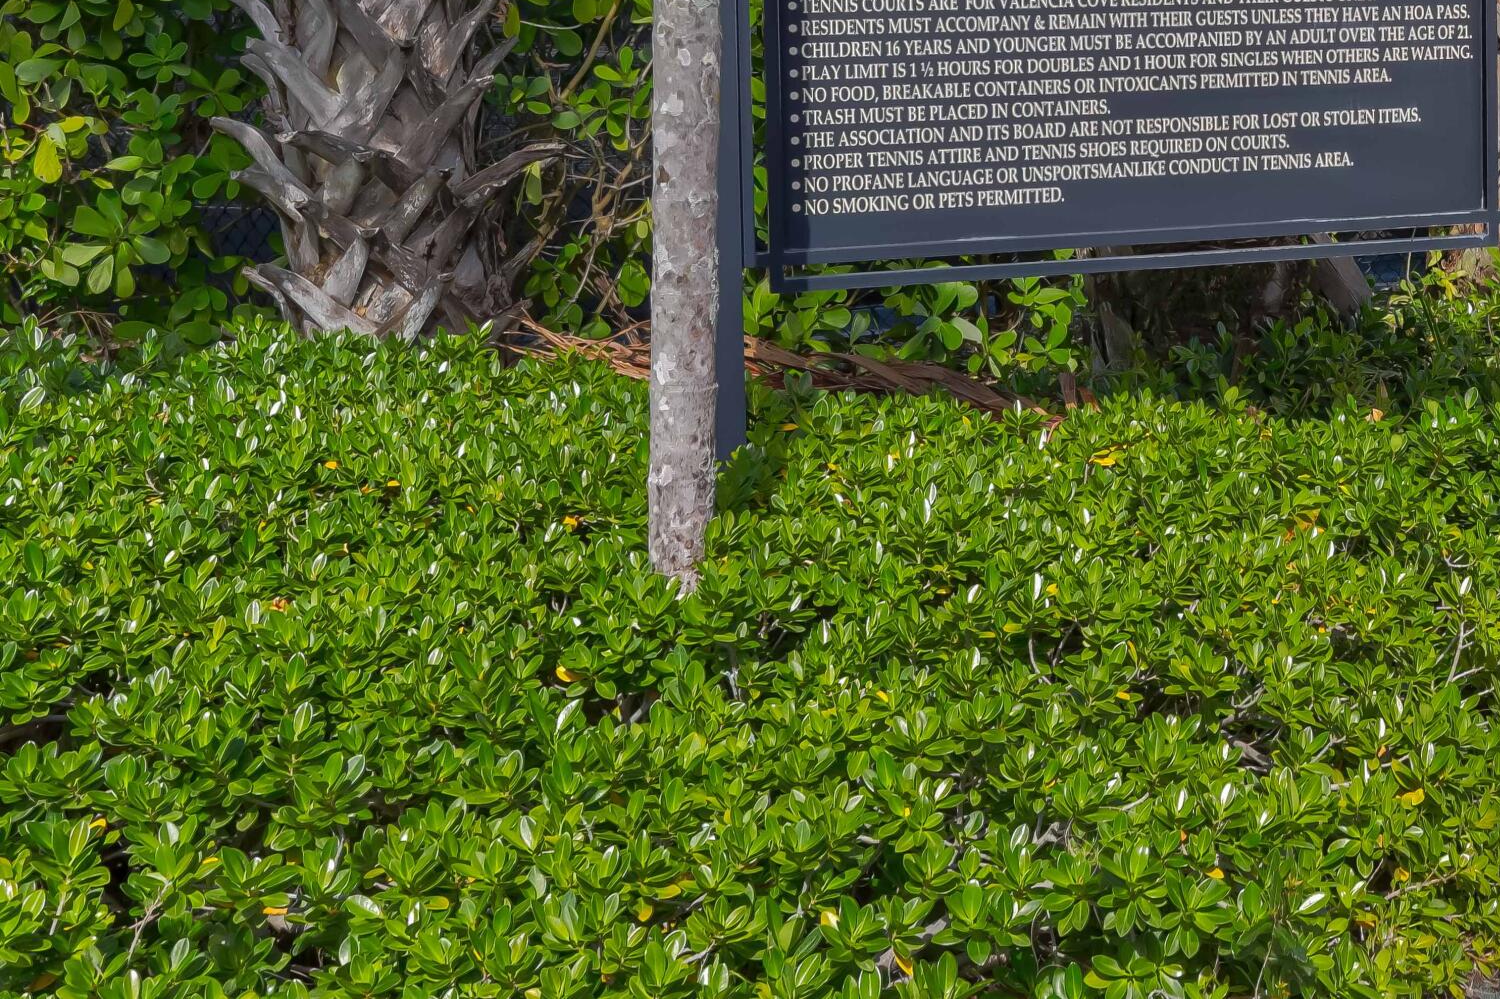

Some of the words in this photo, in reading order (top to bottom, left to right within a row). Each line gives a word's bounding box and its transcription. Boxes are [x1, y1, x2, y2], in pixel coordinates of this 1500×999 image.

[801, 18, 885, 36] RESIDENTS
[887, 17, 932, 34] MUST
[934, 14, 1031, 33] ACCOMPANY
[1033, 14, 1046, 31] &
[1048, 12, 1107, 31] REMAIN
[1108, 11, 1148, 29] WITH
[1150, 10, 1193, 28] THEIR
[1195, 9, 1249, 27] GUESTS
[1250, 7, 1302, 25] UNLESS
[1304, 7, 1340, 24] THEY
[1341, 5, 1380, 23] HAVE
[1381, 5, 1402, 22] AN
[1403, 4, 1434, 21] HOA
[1436, 3, 1471, 20] PASS.
[801, 40, 882, 59] CHILDREN
[885, 39, 901, 57] 16
[903, 38, 953, 56] YEARS
[955, 37, 991, 55] AND
[992, 35, 1068, 53] YOUNGER
[1069, 34, 1112, 51] MUST
[1114, 33, 1133, 50] BE
[1135, 30, 1243, 50] ACCOMPANIED
[1245, 30, 1263, 46] BY
[1265, 29, 1287, 46] AN
[1289, 27, 1337, 45] ADULT
[1338, 26, 1377, 44] OVER
[1378, 25, 1406, 42] THE
[1407, 25, 1436, 41] AGE
[1437, 24, 1456, 40] OF
[1457, 24, 1473, 40] 21.
[802, 64, 841, 81] PLAY
[844, 62, 889, 80] LIMIT
[892, 62, 907, 78] IS
[909, 62, 917, 78] 1
[937, 59, 991, 77] HOURS
[993, 58, 1024, 75] FOR
[1026, 56, 1095, 74] DOUBLES
[1097, 55, 1132, 72] AND
[1133, 55, 1141, 71] 1
[1143, 54, 1187, 70] HOUR
[1189, 52, 1218, 69] FOR
[1220, 50, 1279, 68] SINGLES
[1280, 49, 1324, 65] WHEN
[1325, 47, 1380, 64] OTHERS
[1382, 46, 1409, 62] ARE
[1410, 44, 1474, 61] WAITING.
[802, 86, 827, 103] NO
[830, 85, 879, 104] FOOD,
[882, 81, 971, 101] BREAKABLE
[973, 78, 1071, 97] CONTAINERS
[1074, 78, 1097, 94] OR
[1098, 74, 1197, 93] INTOXICANTS
[1200, 71, 1280, 90] PERMITTED
[1281, 70, 1298, 87] IN
[1300, 68, 1351, 86] TENNIS
[1353, 67, 1392, 84] AREA.
[802, 108, 856, 126] TRASH
[859, 106, 905, 124] MUST
[907, 105, 926, 122] BE
[929, 103, 989, 121] PLACED
[991, 102, 1009, 119] IN
[1011, 98, 1111, 118] CONTAINERS.
[802, 131, 835, 148] THE
[838, 126, 945, 147] ASSOCIATION
[948, 125, 984, 143] AND
[986, 124, 1010, 141] ITS
[1012, 122, 1066, 140] BOARD
[1069, 120, 1099, 138] ARE
[1101, 119, 1134, 136] NOT
[1135, 115, 1230, 135] RESPONSIBLE
[1232, 113, 1261, 131] FOR
[1262, 111, 1299, 129] LOST
[1300, 111, 1321, 128] OR
[1323, 108, 1376, 127] STOLEN
[1378, 106, 1422, 124] ITEMS.
[804, 152, 864, 170] PROPER
[866, 149, 924, 168] TENNIS
[927, 147, 982, 165] ATTIRE
[984, 145, 1019, 163] AND
[1021, 142, 1077, 161] TENNIS
[1079, 140, 1127, 158] SHOES
[1129, 137, 1203, 159] REQUIRED
[1205, 136, 1228, 152] ON
[1230, 133, 1290, 151] COURTS.
[804, 176, 829, 193] NO
[832, 172, 905, 192] PROFANE
[907, 168, 994, 189] LANGUAGE
[996, 167, 1019, 184] OR
[1021, 159, 1167, 183] UNSPORTSMANLIKE
[1168, 156, 1240, 176] CONDUCT
[1242, 155, 1259, 172] IN
[1260, 152, 1312, 171] TENNIS
[1314, 151, 1354, 168] AREA.
[804, 198, 829, 216] NO
[832, 194, 910, 214] SMOKING
[912, 193, 936, 210] OR
[938, 190, 974, 209] PETS
[977, 186, 1065, 207] PERMITTED.
